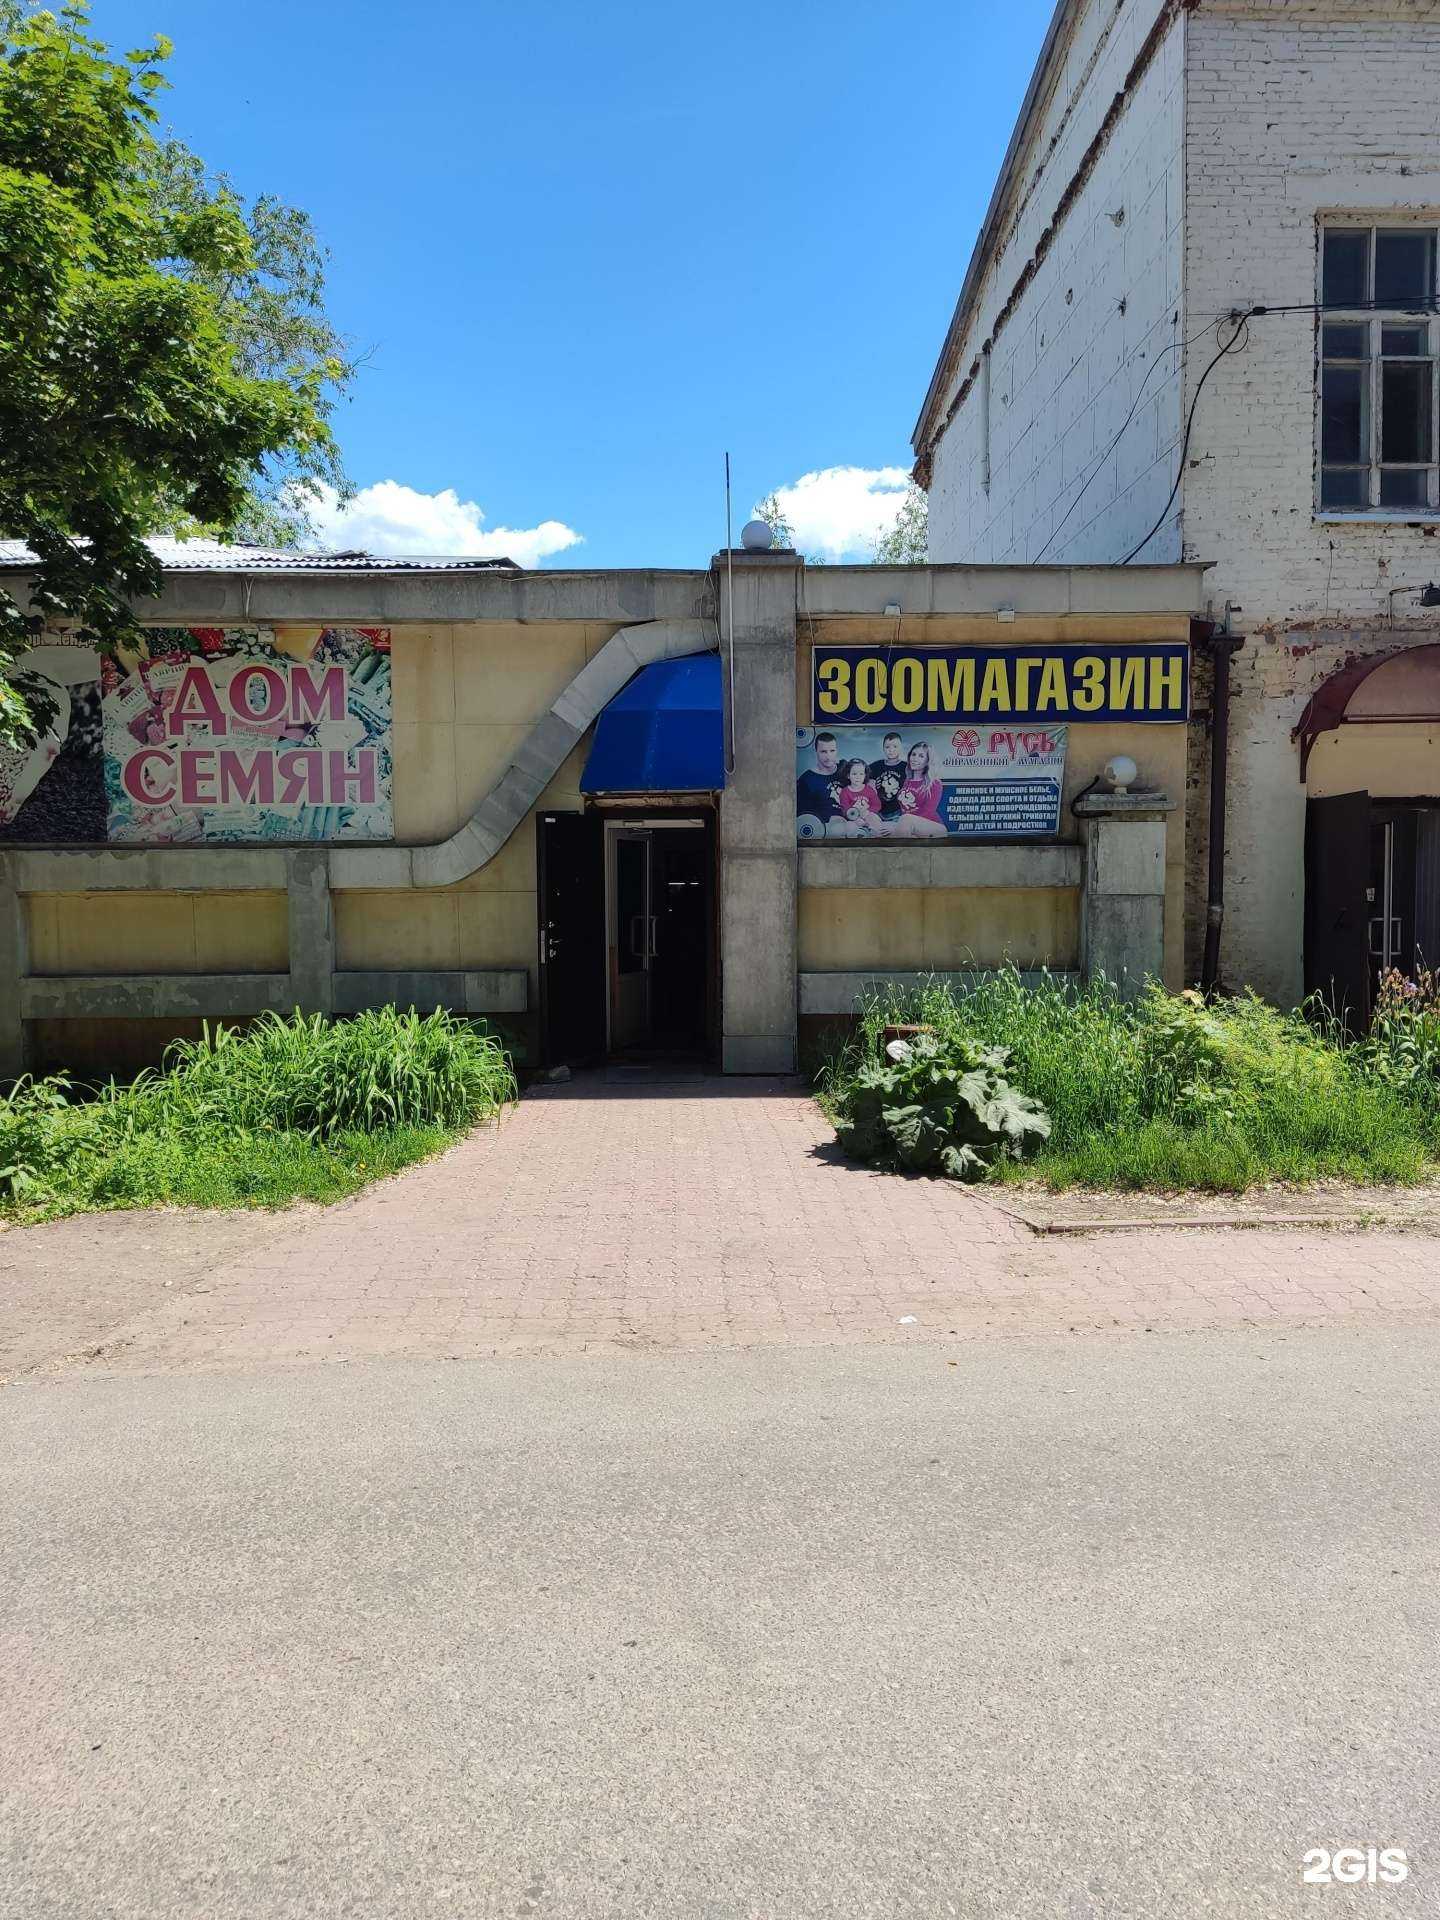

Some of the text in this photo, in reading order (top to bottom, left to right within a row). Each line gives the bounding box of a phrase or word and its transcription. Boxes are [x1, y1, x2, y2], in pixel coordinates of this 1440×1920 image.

[819, 656, 1183, 714] ЗООМАГАЗИН
[170, 666, 346, 736] ДОМ
[987, 732, 1056, 760] РУСЬ
[1018, 757, 1063, 766] МАГАЗИН
[124, 749, 375, 805] СЕМЯН
[956, 787, 988, 795] ЖЕНСКОЕ
[995, 786, 1028, 794] МУЖСКОЕ
[949, 796, 979, 804] ОДЕЖДА
[980, 795, 995, 803] ДЛЯ
[996, 795, 1022, 803] СПОРТА
[1029, 795, 1057, 803] ОТДЫХА
[947, 805, 979, 813] ИЗДЕЛИЯ
[949, 814, 984, 822] БЕЛЬЕВОЙ
[991, 813, 1021, 821] ВЕРХНИЙ
[959, 821, 1048, 831] ДЛЯ ДЕТЕЙ И ПОДРОСТКОВ
